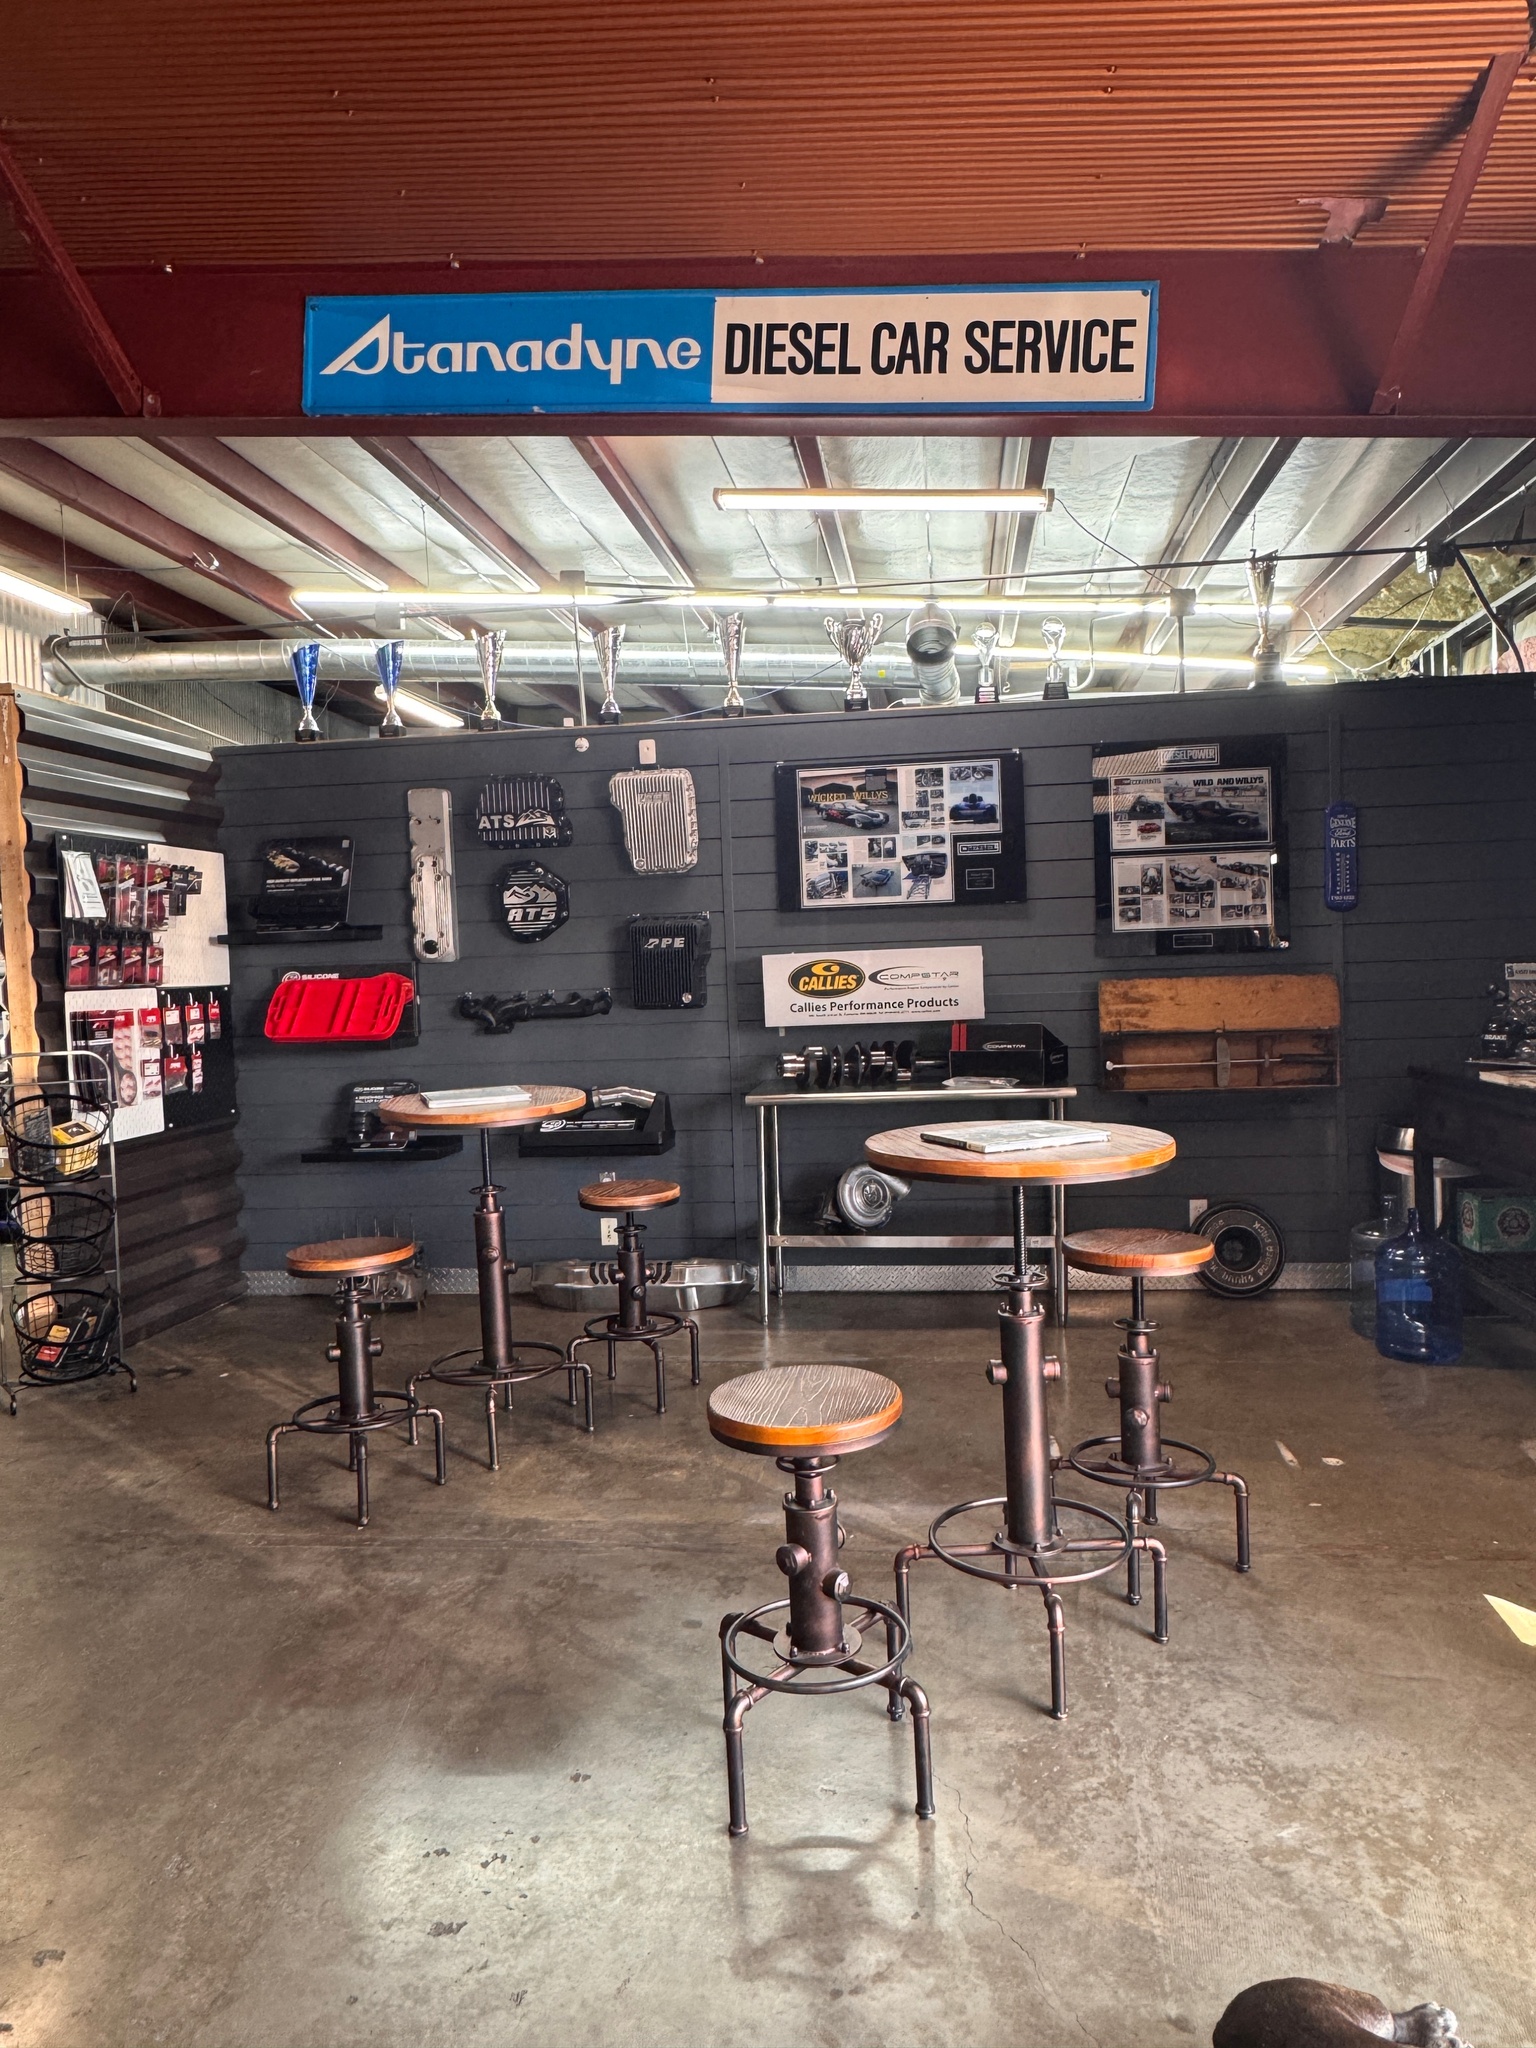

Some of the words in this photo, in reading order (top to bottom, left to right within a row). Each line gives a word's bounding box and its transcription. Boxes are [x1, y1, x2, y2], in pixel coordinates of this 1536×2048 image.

[319, 313, 701, 385] Stanadyne
[725, 322, 862, 375] DIESEL
[871, 320, 949, 376] CAR
[963, 318, 1136, 375] SERVICE
[1193, 779, 1213, 787] WILD
[807, 793, 847, 803] WICKED
[853, 791, 889, 801] WILLYS
[478, 814, 515, 830] ATS
[1331, 837, 1356, 848] PARTS
[507, 906, 556, 921] ATS
[798, 975, 858, 991] CALLIES
[879, 971, 959, 981] COMPSTAR
[790, 1002, 827, 1013] Callies
[830, 999, 904, 1011] Performance
[907, 997, 959, 1009] Products
